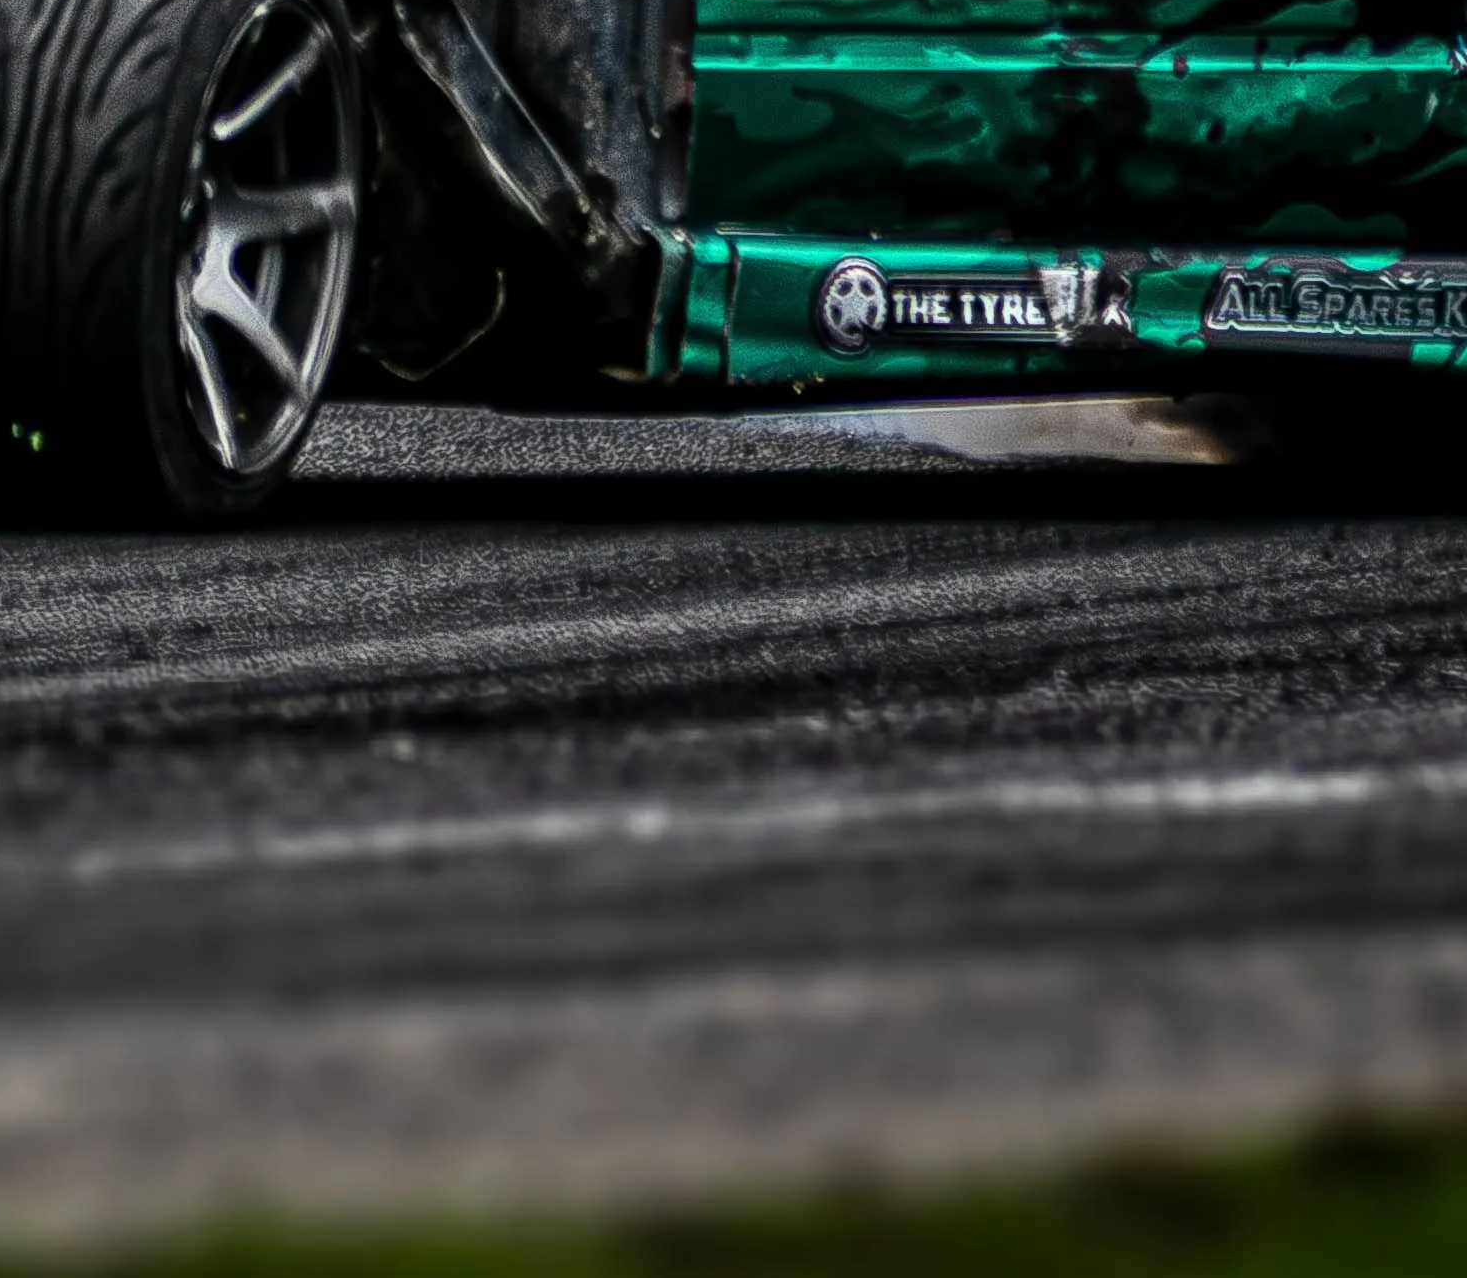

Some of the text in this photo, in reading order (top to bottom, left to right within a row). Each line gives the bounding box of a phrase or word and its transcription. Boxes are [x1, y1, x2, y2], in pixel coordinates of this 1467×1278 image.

[891, 292, 952, 325] THE
[959, 292, 1047, 326] TYRE
[1216, 281, 1290, 324] ALL
[1296, 283, 1436, 329] SPARES
